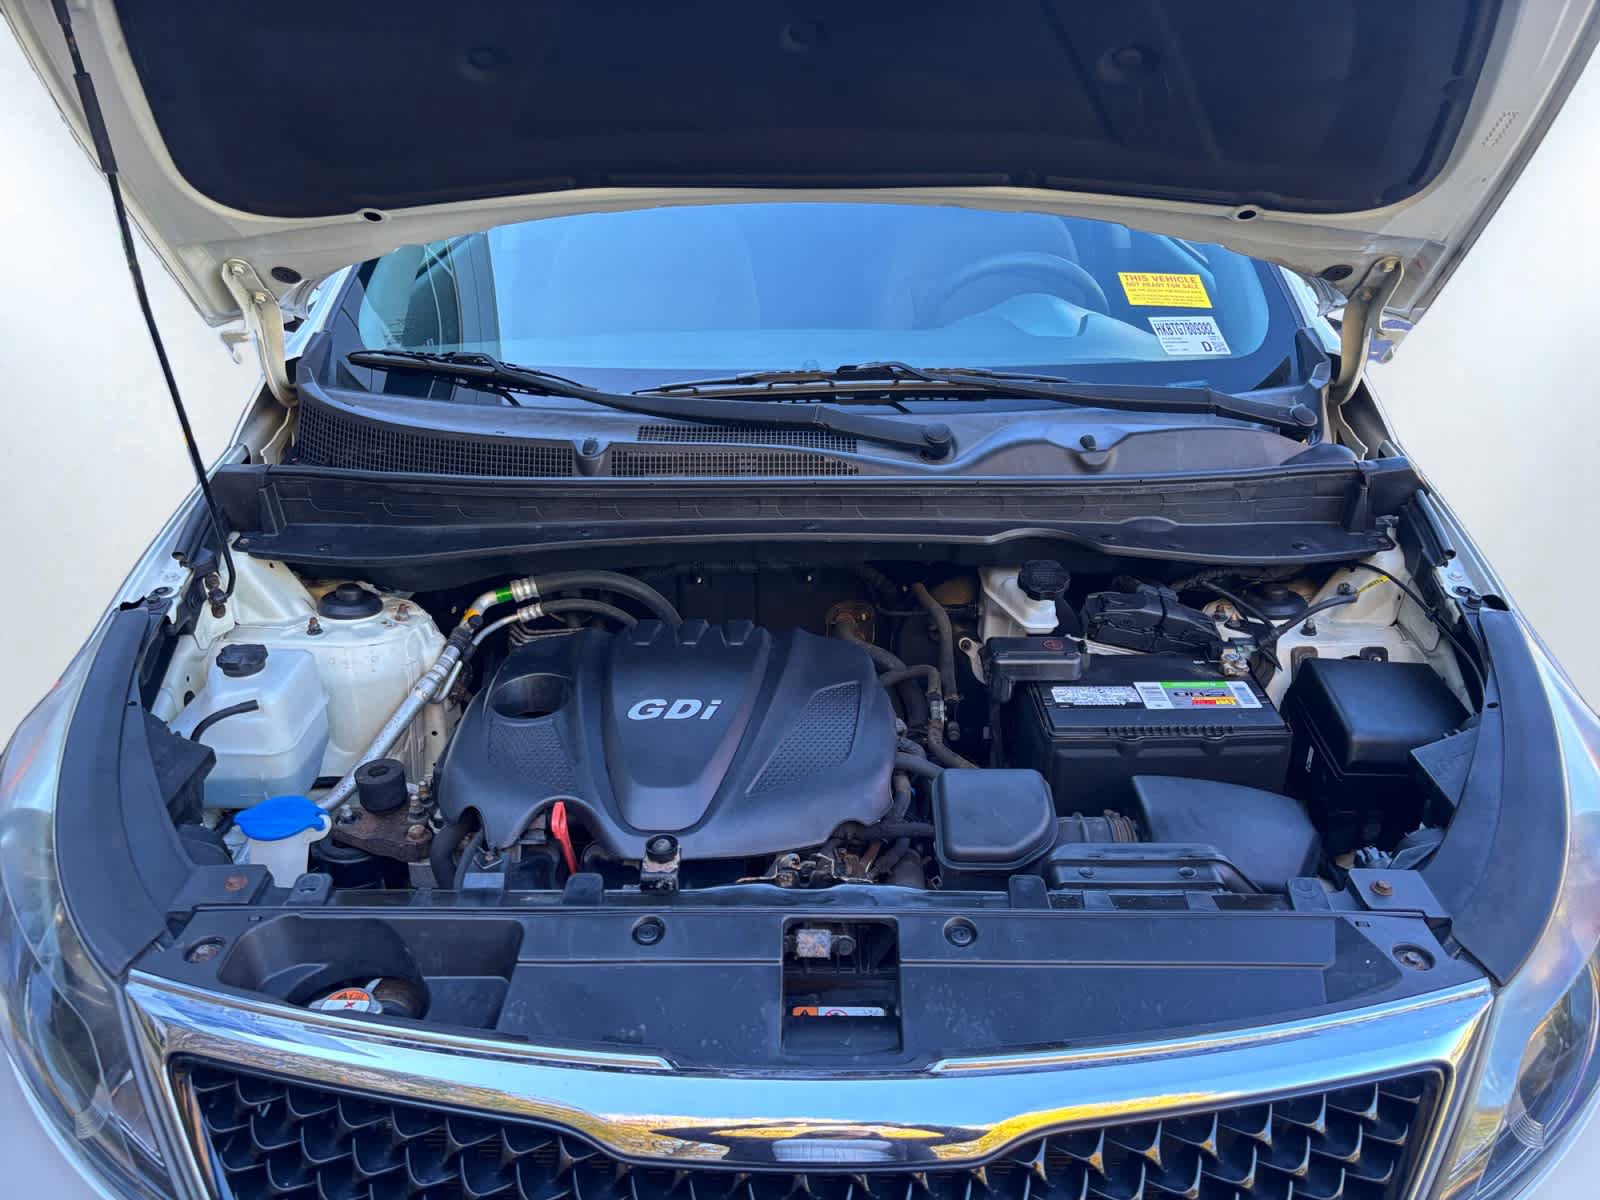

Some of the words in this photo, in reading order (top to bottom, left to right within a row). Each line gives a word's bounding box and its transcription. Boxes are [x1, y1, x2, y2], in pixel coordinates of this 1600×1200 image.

[1124, 274, 1149, 282] THIS
[1152, 275, 1198, 283] VEHICLE
[1201, 341, 1213, 352] D
[627, 698, 723, 721] GDi
